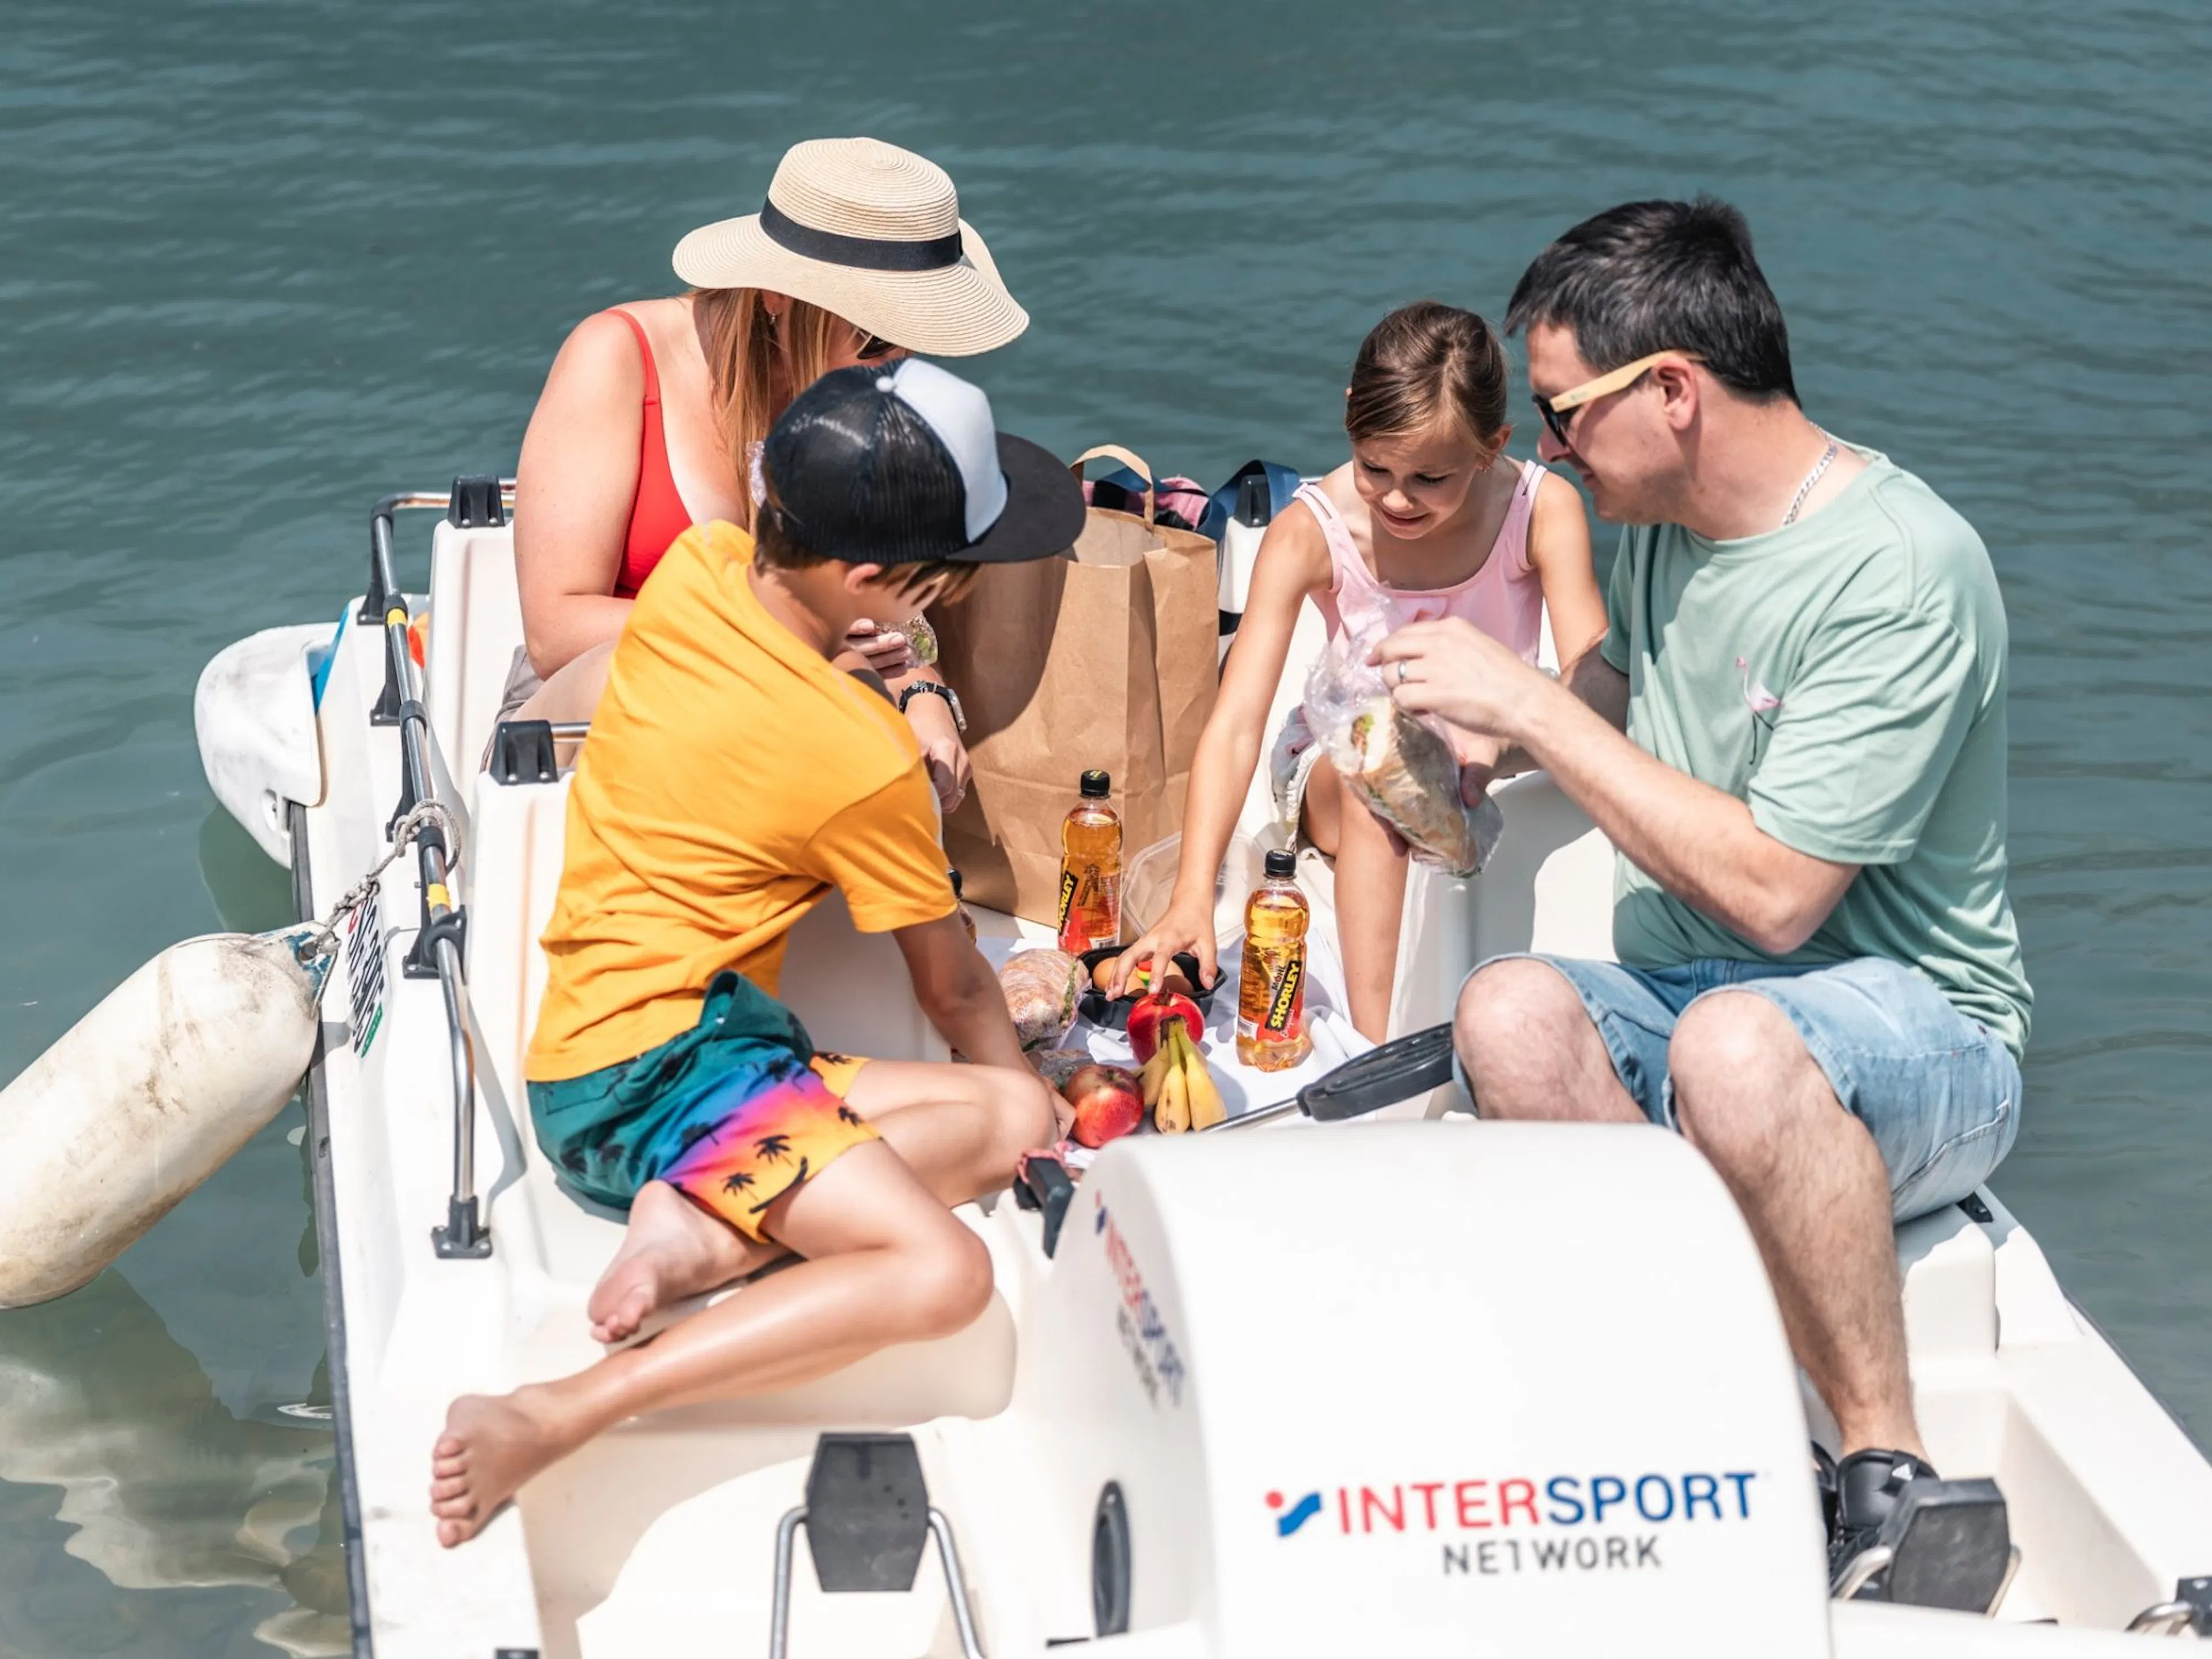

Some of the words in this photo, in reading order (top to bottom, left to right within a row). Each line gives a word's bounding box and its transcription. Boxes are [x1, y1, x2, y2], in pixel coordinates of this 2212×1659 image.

[1270, 963, 1300, 1028] SHORLEY
[1338, 1471, 1757, 1533] INTERSPORT
[1443, 1535, 1662, 1574] NETWORK
